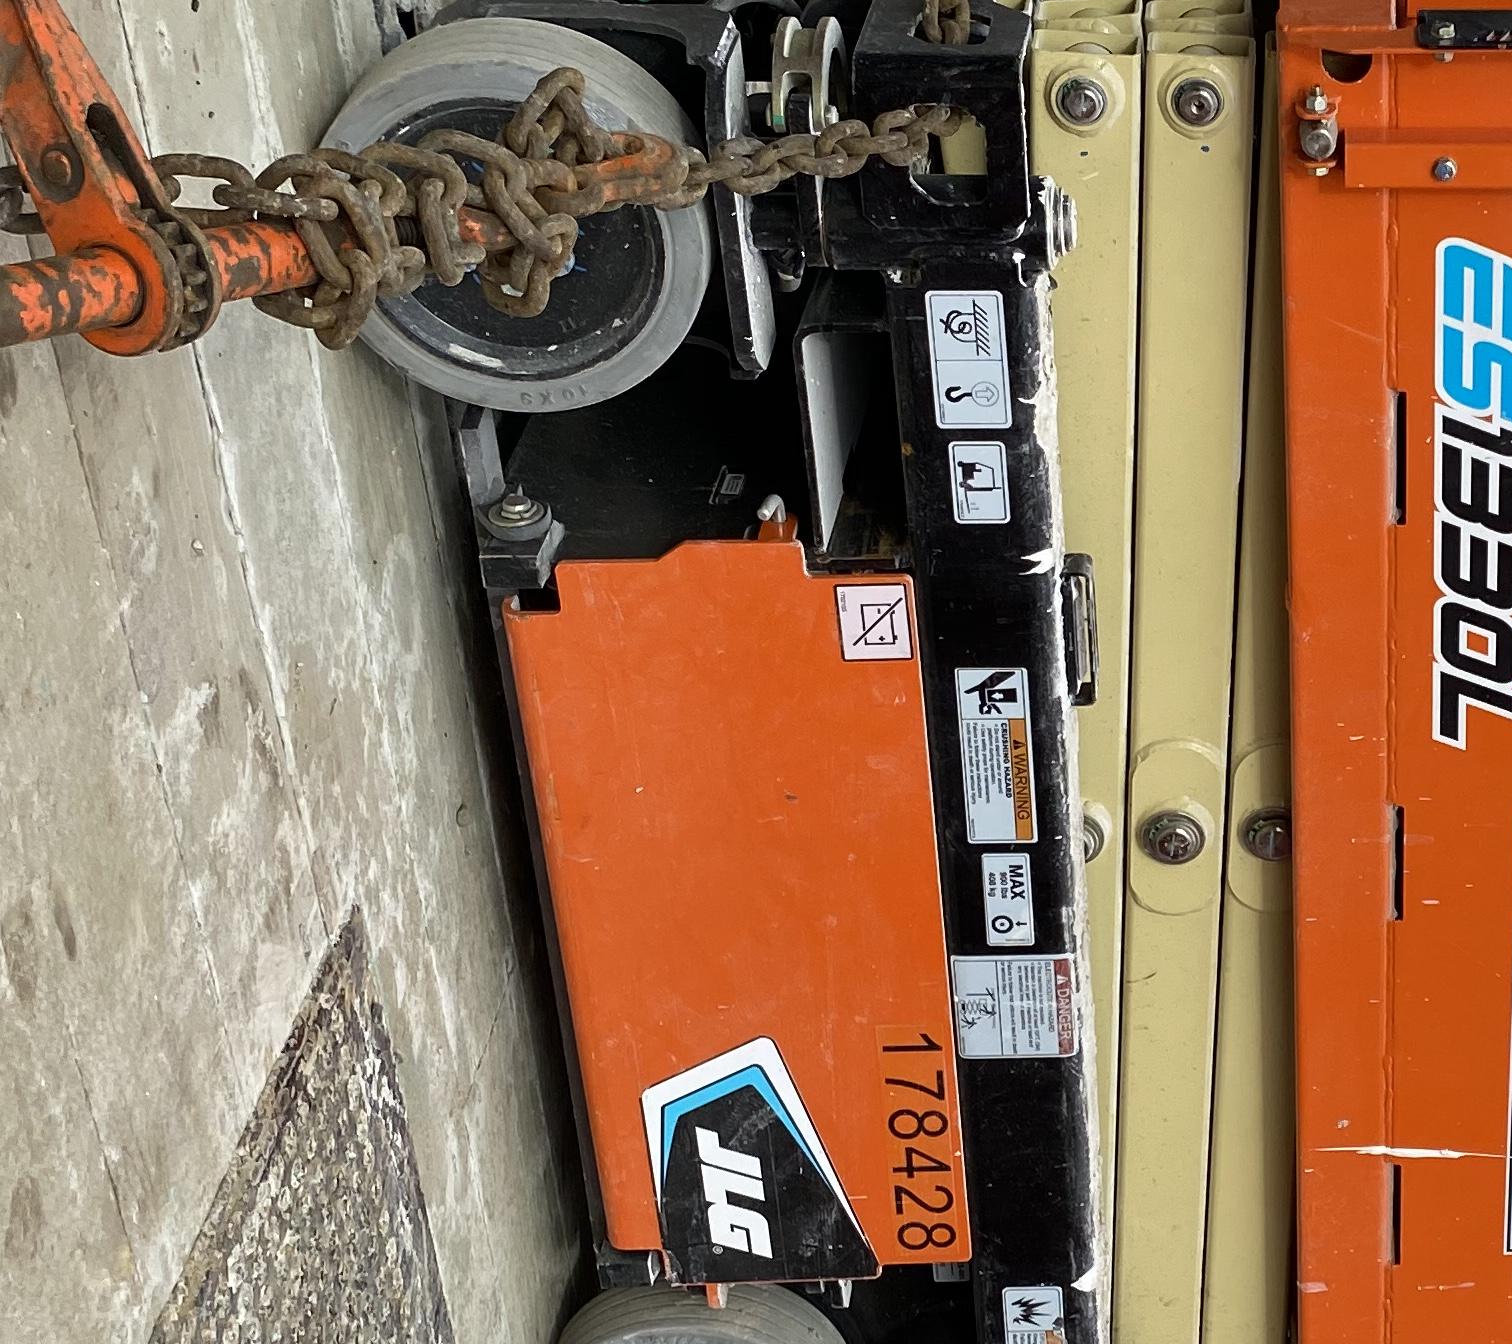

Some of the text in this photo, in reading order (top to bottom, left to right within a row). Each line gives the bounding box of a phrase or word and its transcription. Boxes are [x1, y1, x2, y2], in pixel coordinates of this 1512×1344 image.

[1001, 723, 1012, 798] CRUSHING HAZARD
[1013, 753, 1030, 820] WARNING
[1009, 865, 1025, 900] MAX
[1057, 988, 1071, 1040] DANGER
[882, 1032, 957, 1251] 178428
[694, 1126, 773, 1259] JLG
